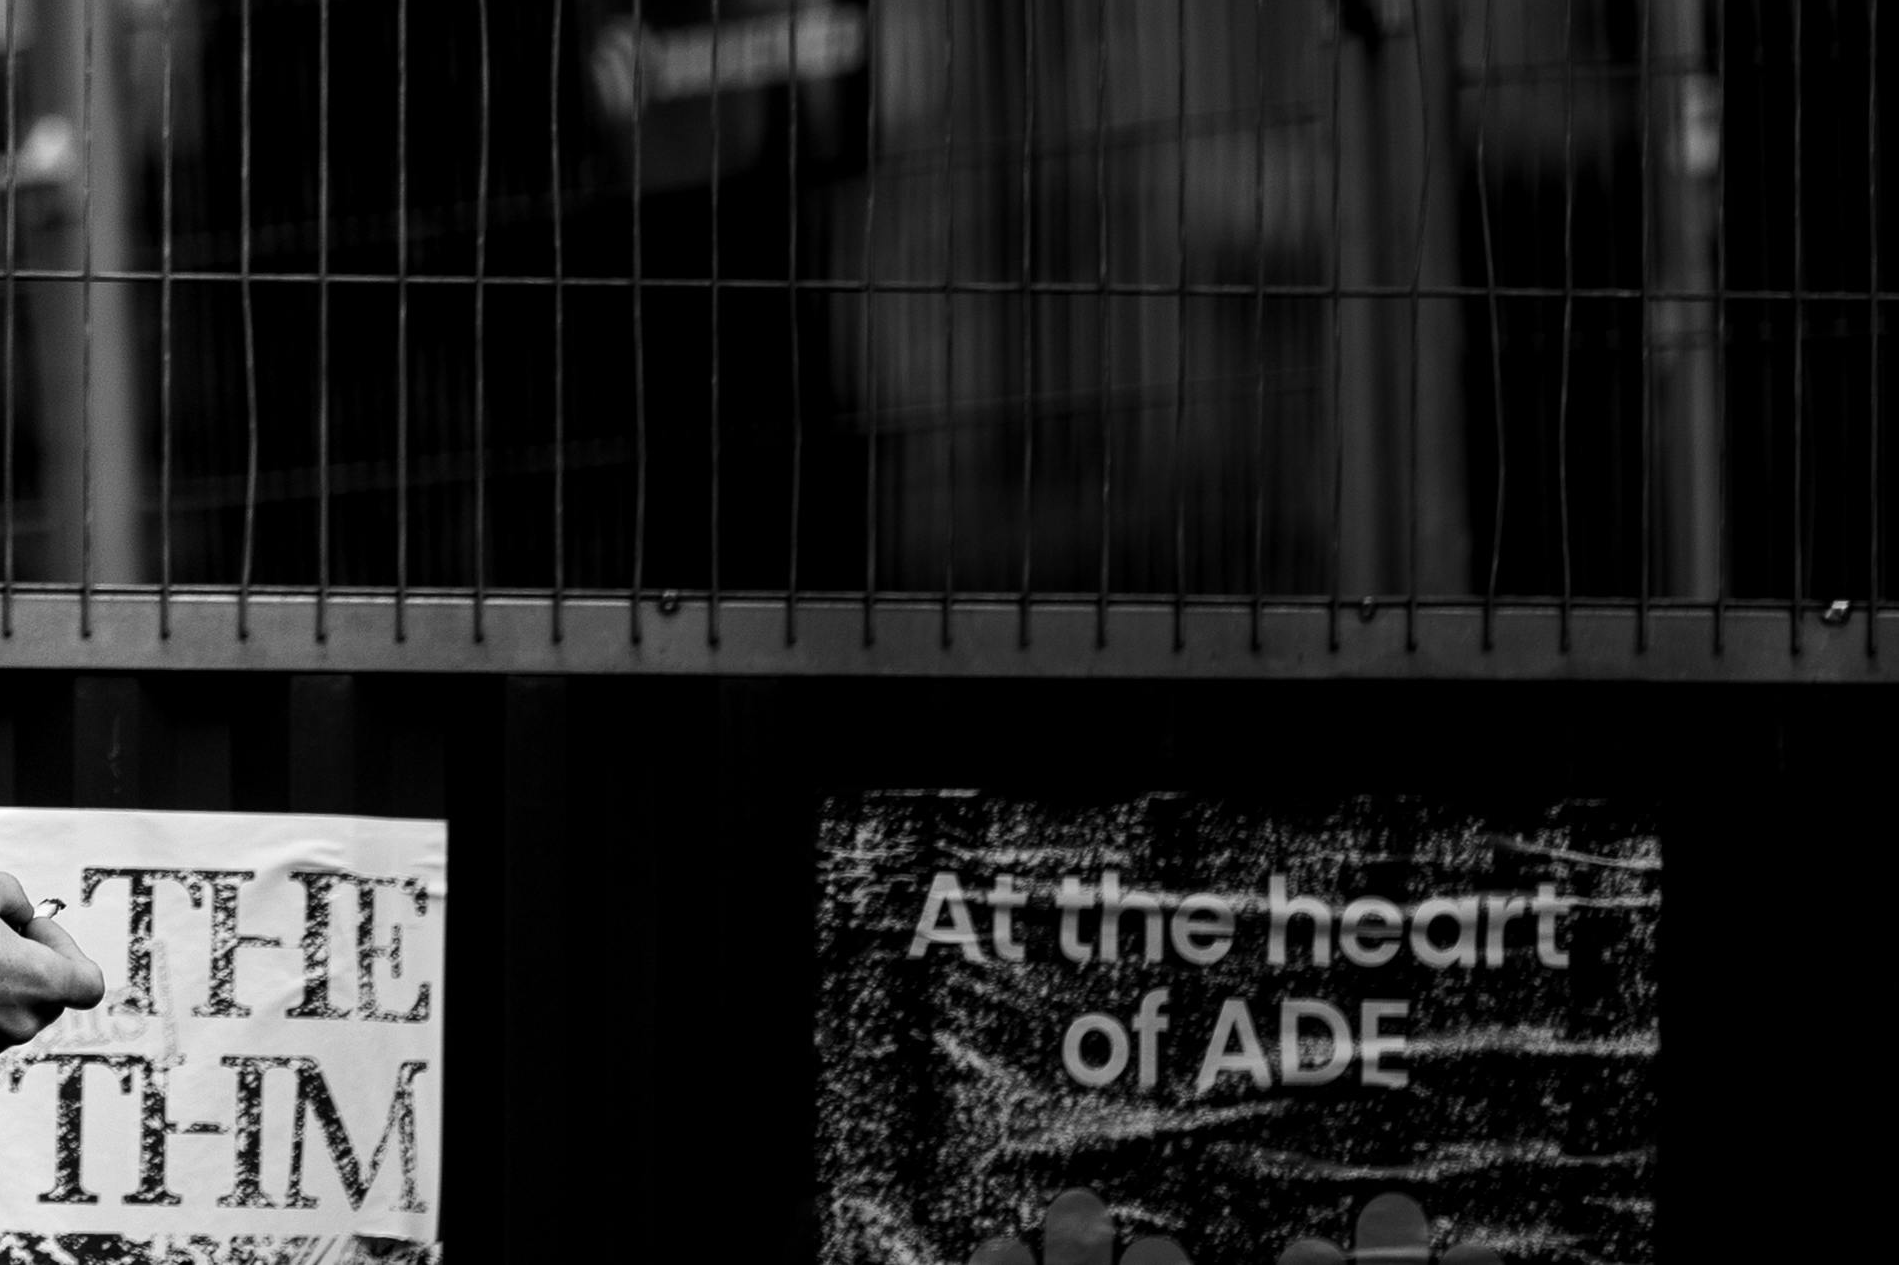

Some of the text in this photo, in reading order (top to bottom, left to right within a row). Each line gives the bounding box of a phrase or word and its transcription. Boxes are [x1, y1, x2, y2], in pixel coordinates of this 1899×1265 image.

[82, 866, 431, 1023] THE
[908, 871, 1569, 968] At the heart
[1062, 988, 1410, 1089] of ADE
